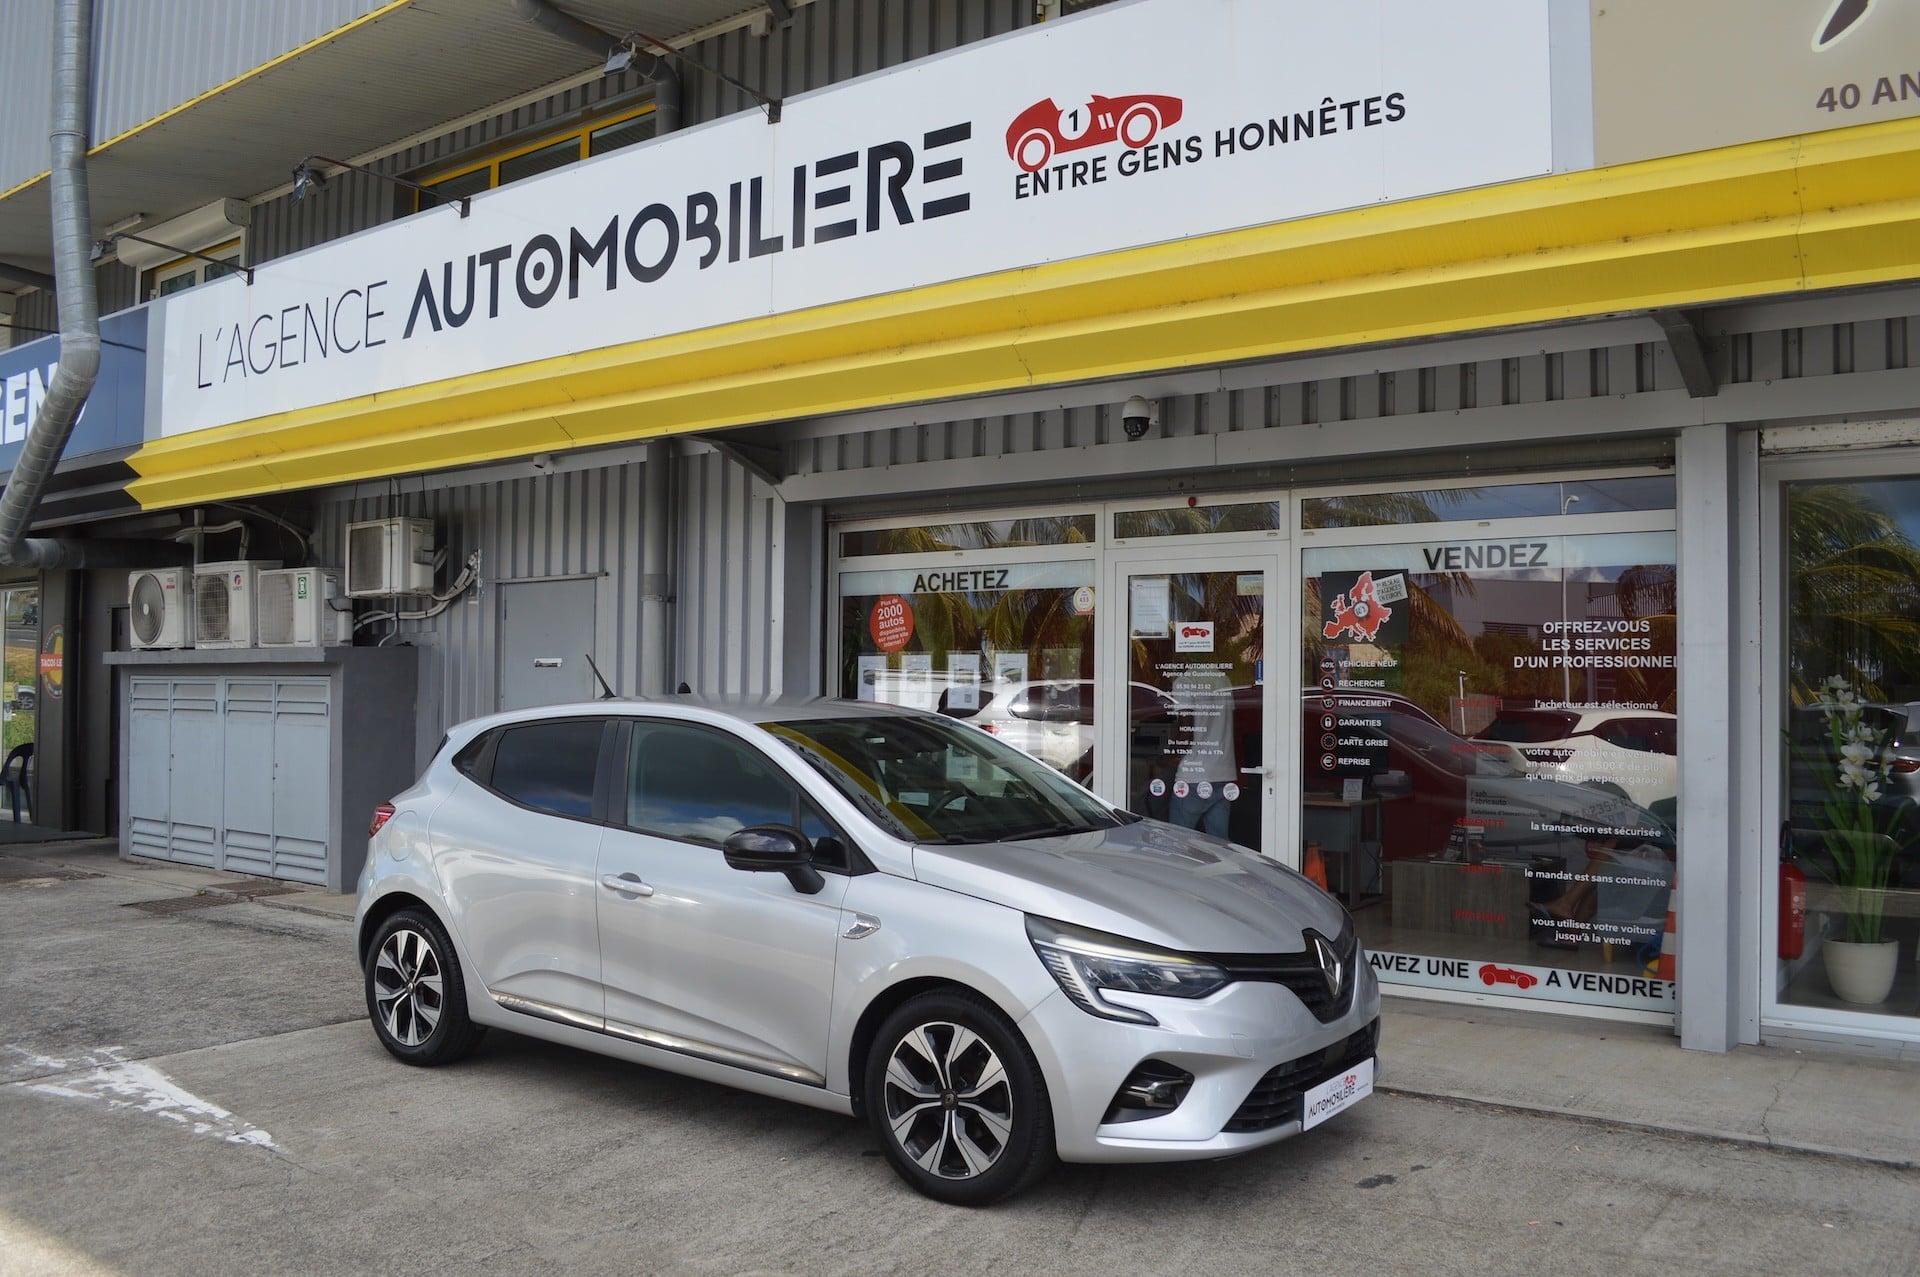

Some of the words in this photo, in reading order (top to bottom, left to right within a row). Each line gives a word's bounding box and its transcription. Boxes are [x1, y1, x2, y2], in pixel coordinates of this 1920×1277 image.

[1816, 84, 1860, 112] 40
[1068, 109, 1079, 132] 1
[1015, 156, 1108, 200] ENTRE
[1117, 136, 1203, 177] GENS
[1215, 92, 1407, 158] HONNÊTES
[198, 280, 388, 389] L'AGENCE
[402, 121, 972, 339] AUTOMOBILIERE
[1422, 543, 1548, 570] VENDEZ
[913, 570, 1008, 592] ACHETEZ
[878, 604, 903, 620] 2000
[880, 617, 904, 629] autos
[1543, 620, 1650, 634] OFFREZ-VOUS
[1542, 639, 1570, 650] LES
[1575, 638, 1651, 650] SERVICES
[1514, 656, 1548, 668] D'UN
[1535, 699, 1582, 709] l'acheteur
[1601, 700, 1658, 710] sélectionné
[1338, 758, 1370, 766] REPRISE
[1531, 822, 1540, 830] la
[1541, 823, 1594, 834] transaction
[1597, 826, 1612, 834] est
[1614, 826, 1662, 838] sécurisée
[1525, 868, 1533, 877] le
[1536, 870, 1572, 880] mandat
[1574, 874, 1589, 882] est
[1616, 876, 1666, 887] contrainte
[1532, 918, 1555, 927] vous
[1557, 919, 1591, 930] utilisez
[1593, 924, 1619, 932] votre
[1621, 925, 1656, 935] voiture
[1555, 931, 1590, 942] jusqu'à
[1592, 933, 1600, 942] la
[1603, 936, 1631, 946] vente
[1370, 953, 1421, 974] AVEZ
[1427, 960, 1469, 979] UNE
[1546, 971, 1562, 988] A
[1568, 972, 1663, 998] VENDRE
